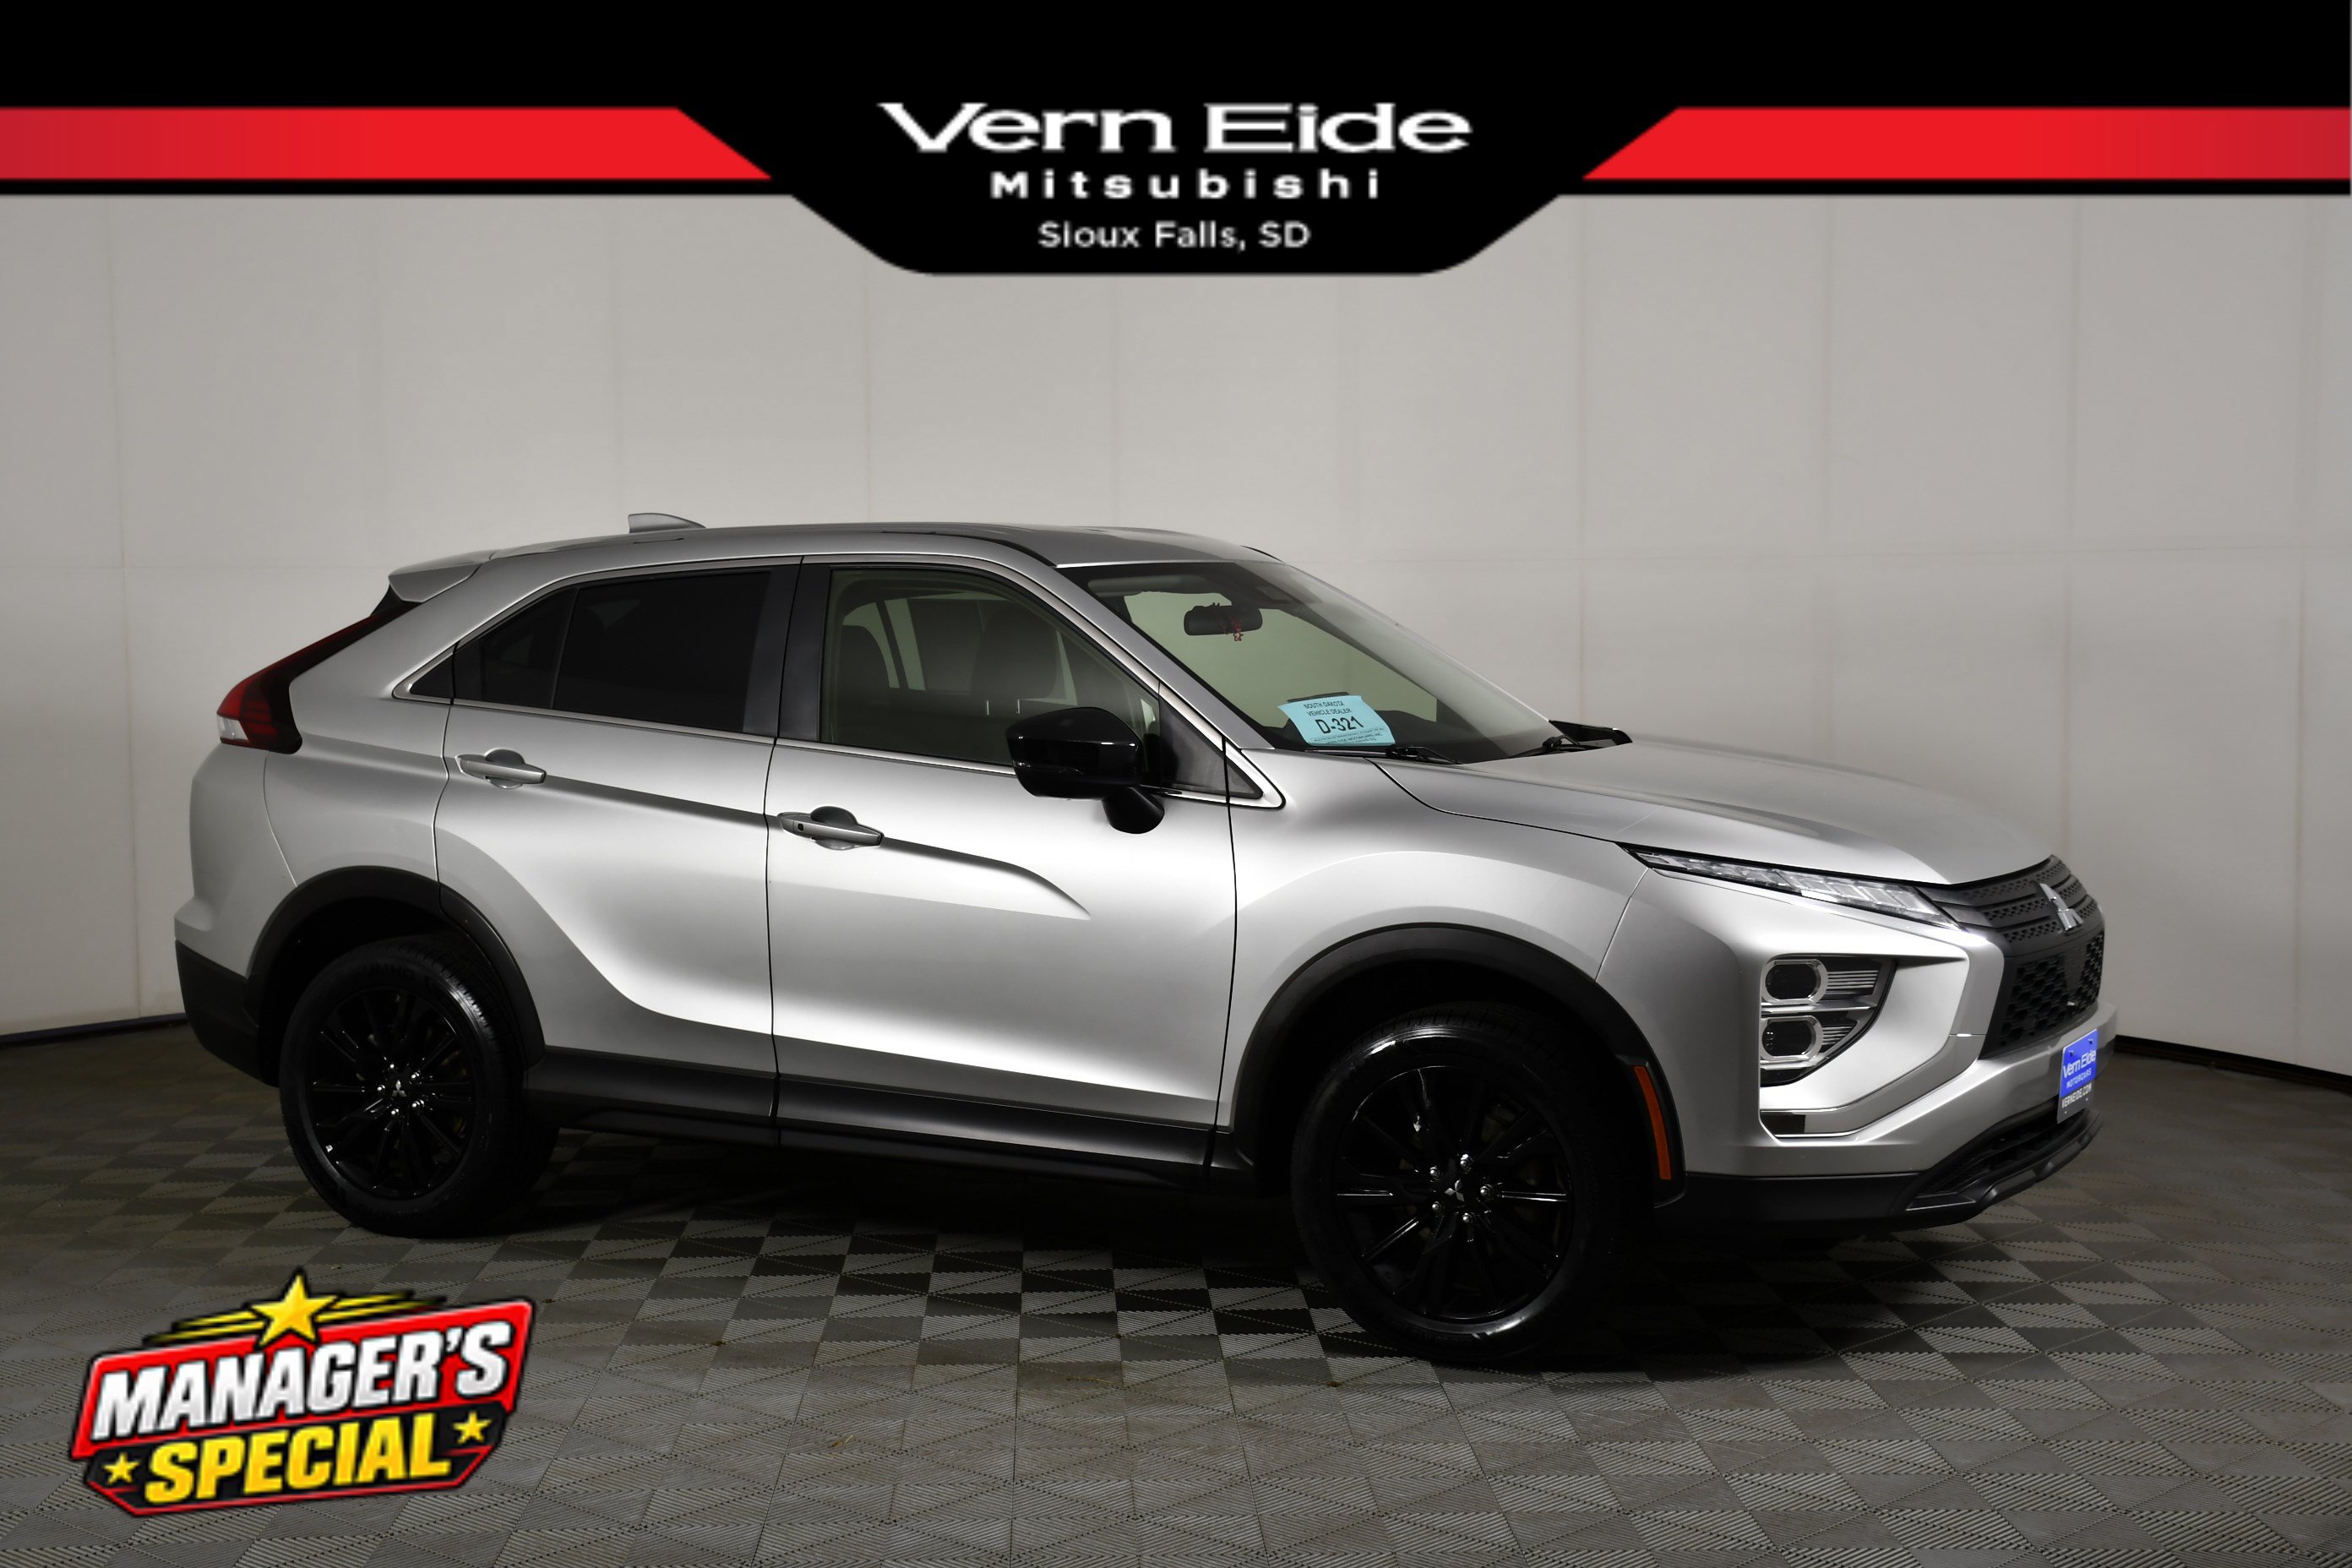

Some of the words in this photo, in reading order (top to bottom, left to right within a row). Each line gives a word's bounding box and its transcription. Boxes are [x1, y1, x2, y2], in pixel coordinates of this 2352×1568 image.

[1315, 716, 1364, 734] D-321
[2063, 1059, 2080, 1078] Vern
[2081, 1049, 2097, 1068] Eide
